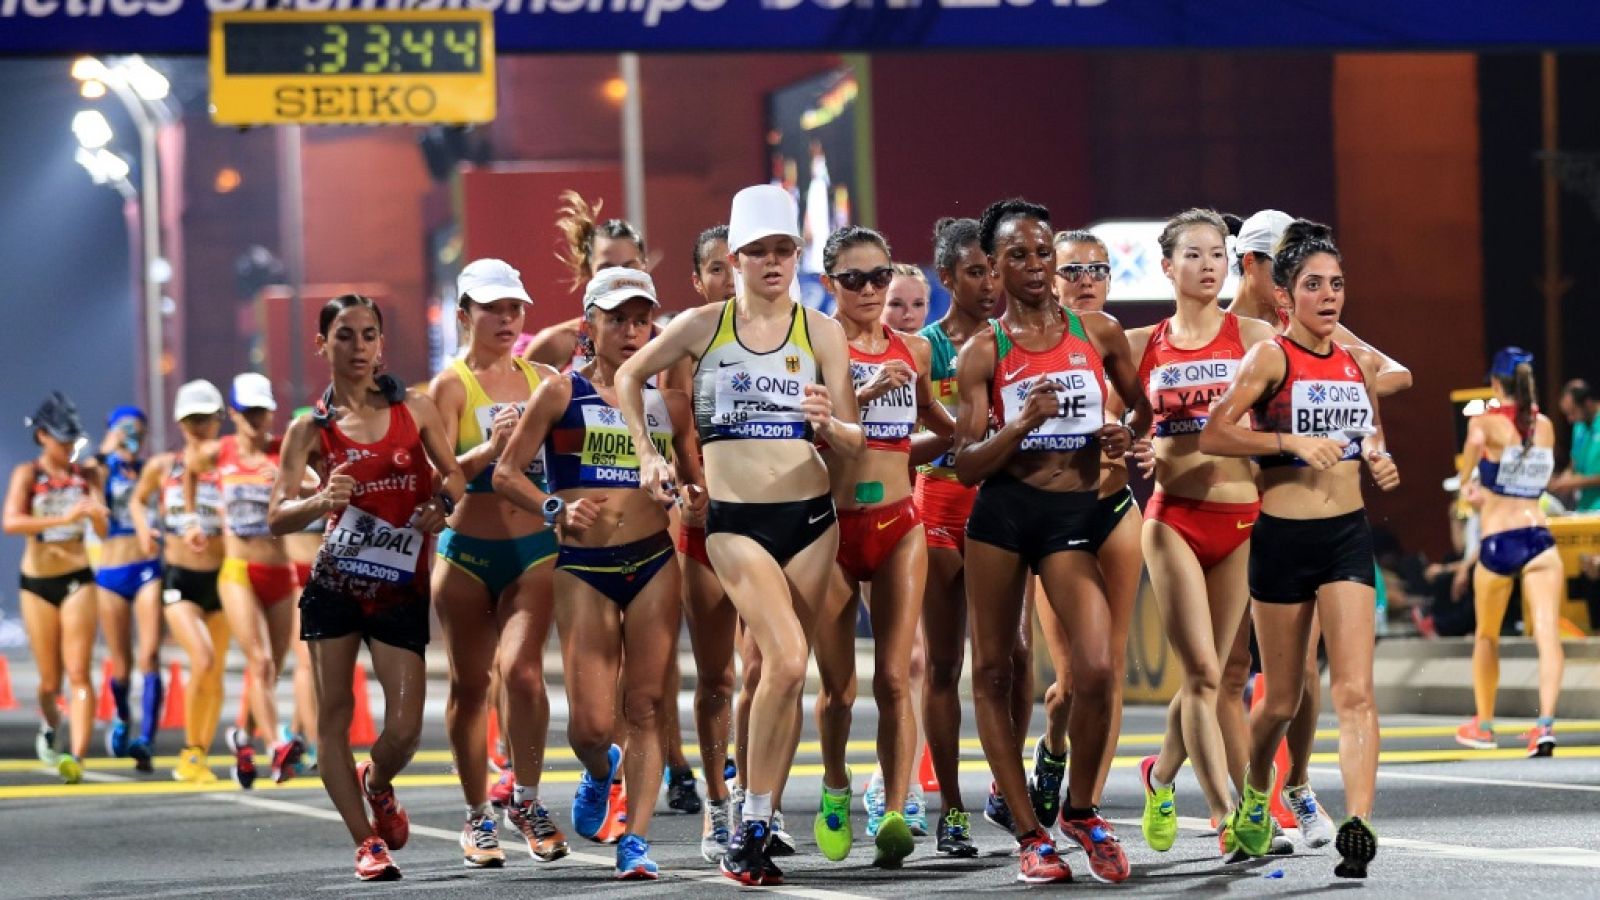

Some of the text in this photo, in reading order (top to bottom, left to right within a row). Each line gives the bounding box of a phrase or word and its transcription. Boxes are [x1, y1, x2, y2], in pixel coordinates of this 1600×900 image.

[274, 84, 437, 118] SEIKO
[1185, 364, 1228, 381] QNB
[755, 376, 799, 396] QNB
[1329, 386, 1360, 402] QNB
[863, 424, 909, 437] HA2019
[1021, 436, 1087, 450] DOHA2019
[338, 528, 413, 556] TEKDAL
[337, 560, 400, 581] DOHA2019
